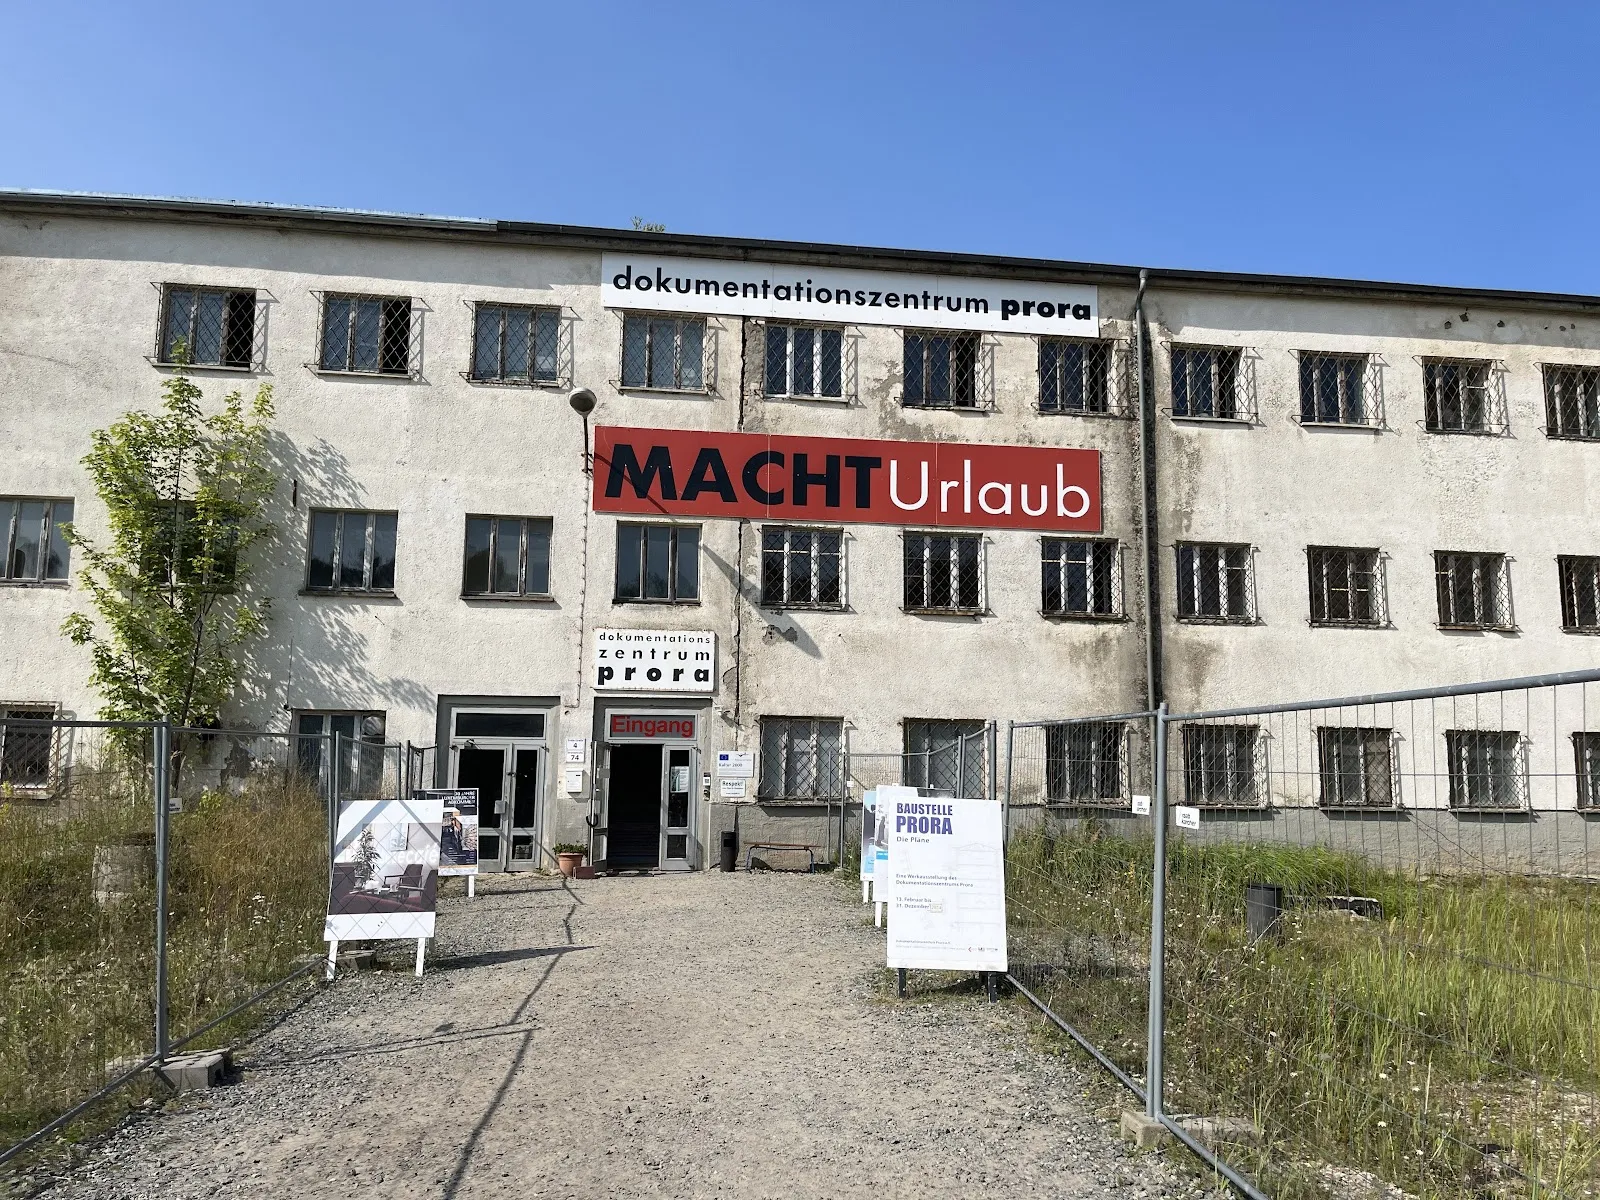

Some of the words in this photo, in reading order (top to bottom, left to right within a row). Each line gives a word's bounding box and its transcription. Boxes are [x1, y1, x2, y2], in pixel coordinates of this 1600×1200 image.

[613, 266, 989, 314] dokumentationszentrum
[1001, 298, 1092, 320] prora
[599, 632, 710, 644] dokumentations
[598, 648, 710, 660] zentrum
[597, 665, 710, 685] prora
[611, 715, 693, 737] Eingang
[896, 803, 953, 816] BAUSTELLE
[896, 816, 953, 835] PRORA
